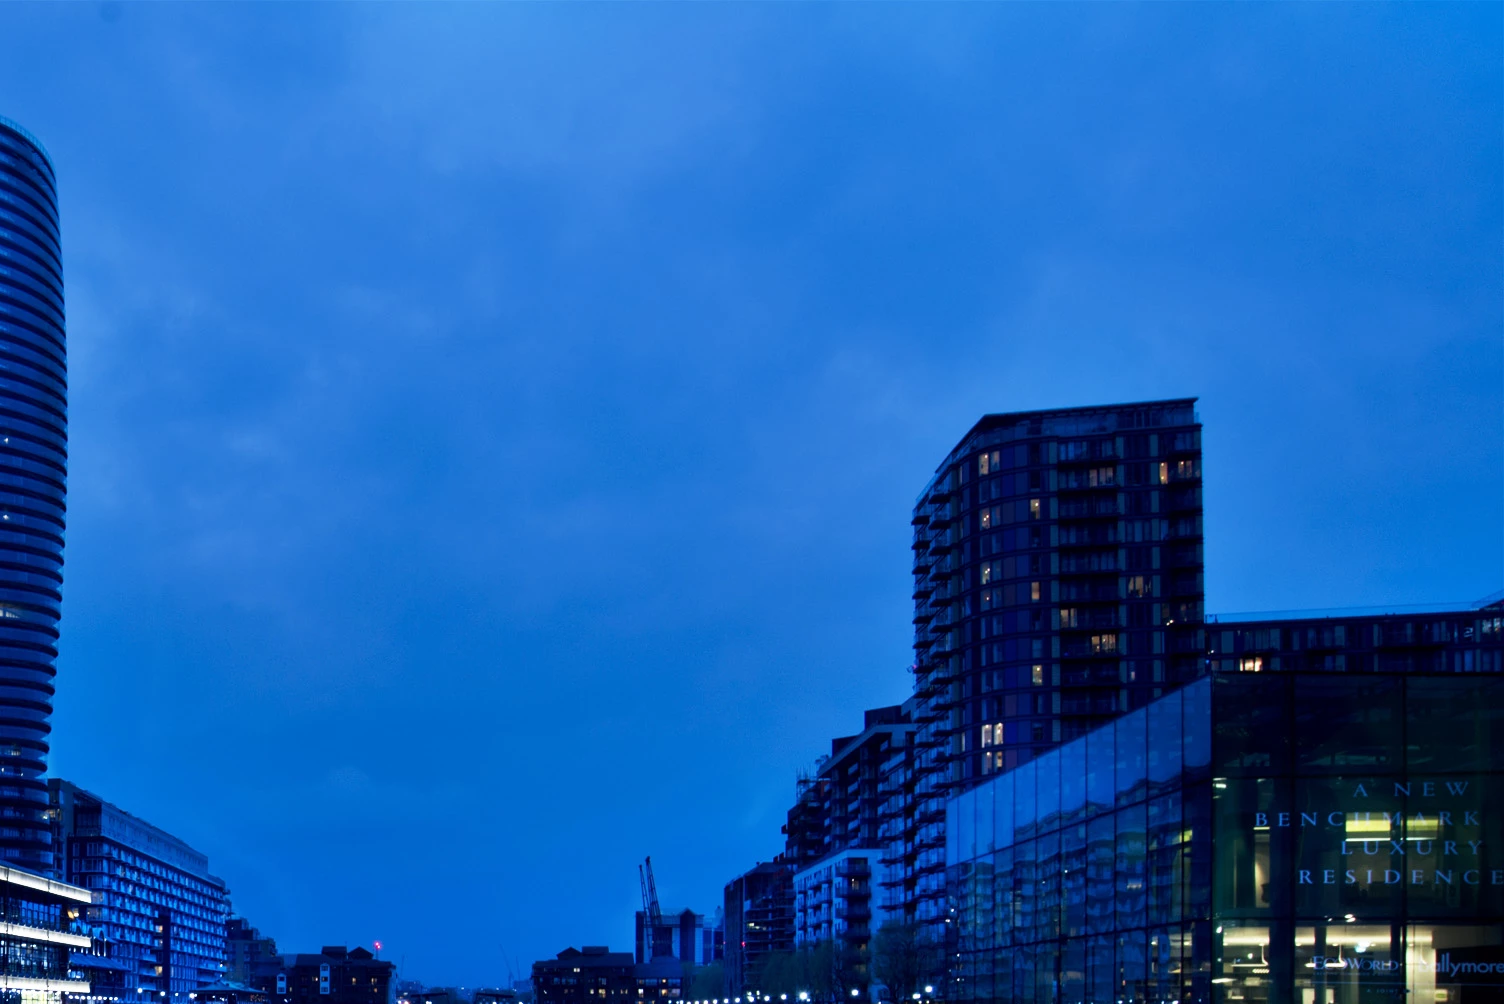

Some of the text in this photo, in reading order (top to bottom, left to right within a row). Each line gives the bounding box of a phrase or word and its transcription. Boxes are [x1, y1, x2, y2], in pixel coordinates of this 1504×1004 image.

[1353, 781, 1469, 798] A NEW
[1255, 811, 1480, 827] BENCHMARK
[1340, 840, 1484, 855] LUXURY
[1299, 869, 1504, 885] RESIDENCE
[1419, 952, 1504, 978] ballymore
